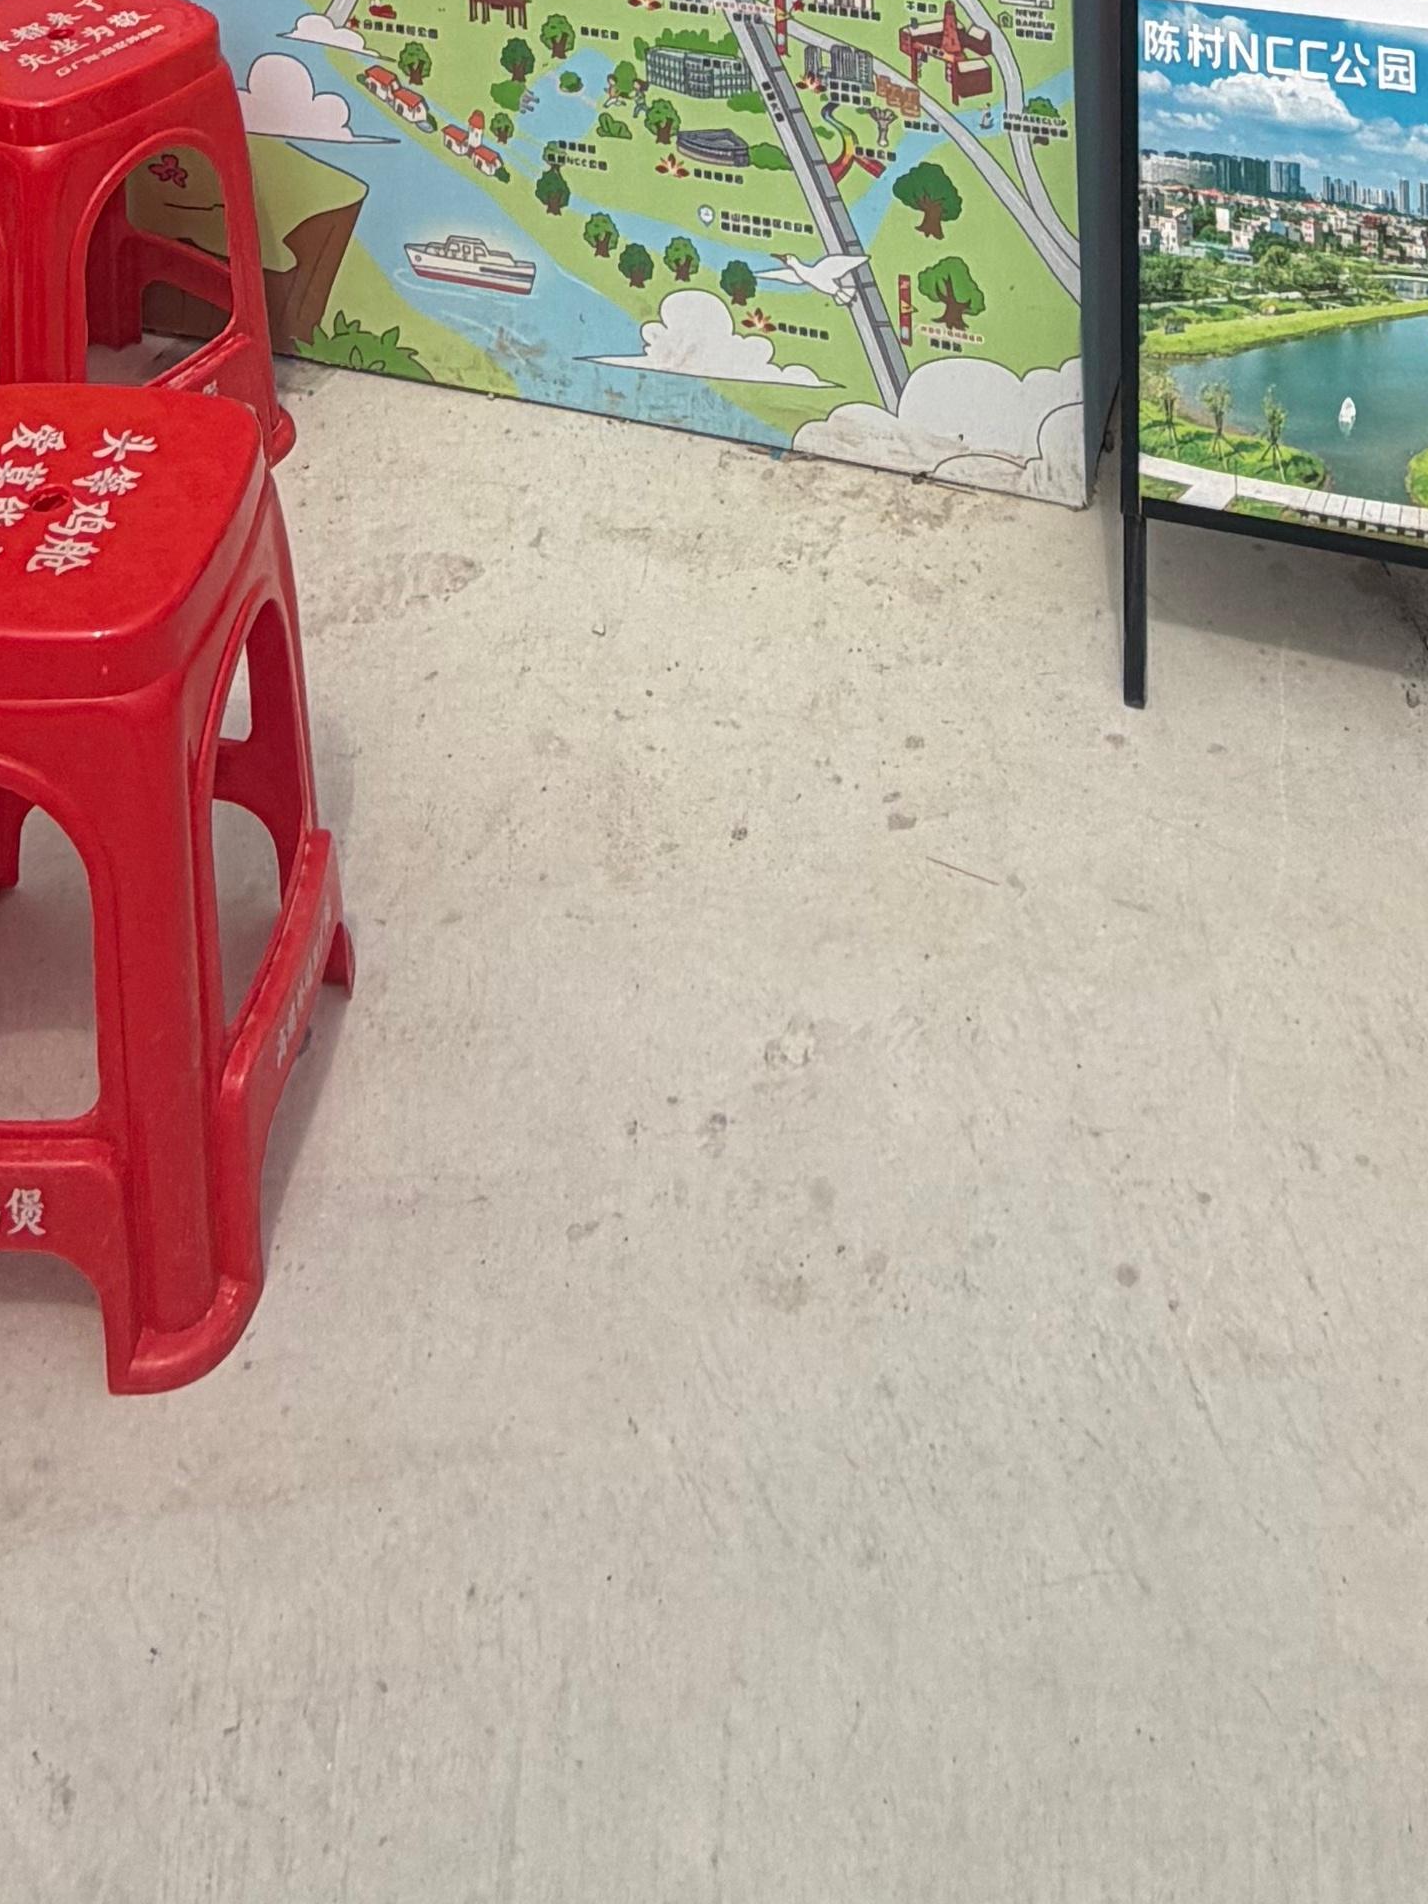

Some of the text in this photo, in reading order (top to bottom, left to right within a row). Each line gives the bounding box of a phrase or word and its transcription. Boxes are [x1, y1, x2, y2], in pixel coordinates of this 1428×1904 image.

[1142, 19, 1418, 95] 陈村NCC公园
[25, 427, 159, 576] 头等鸡舱
